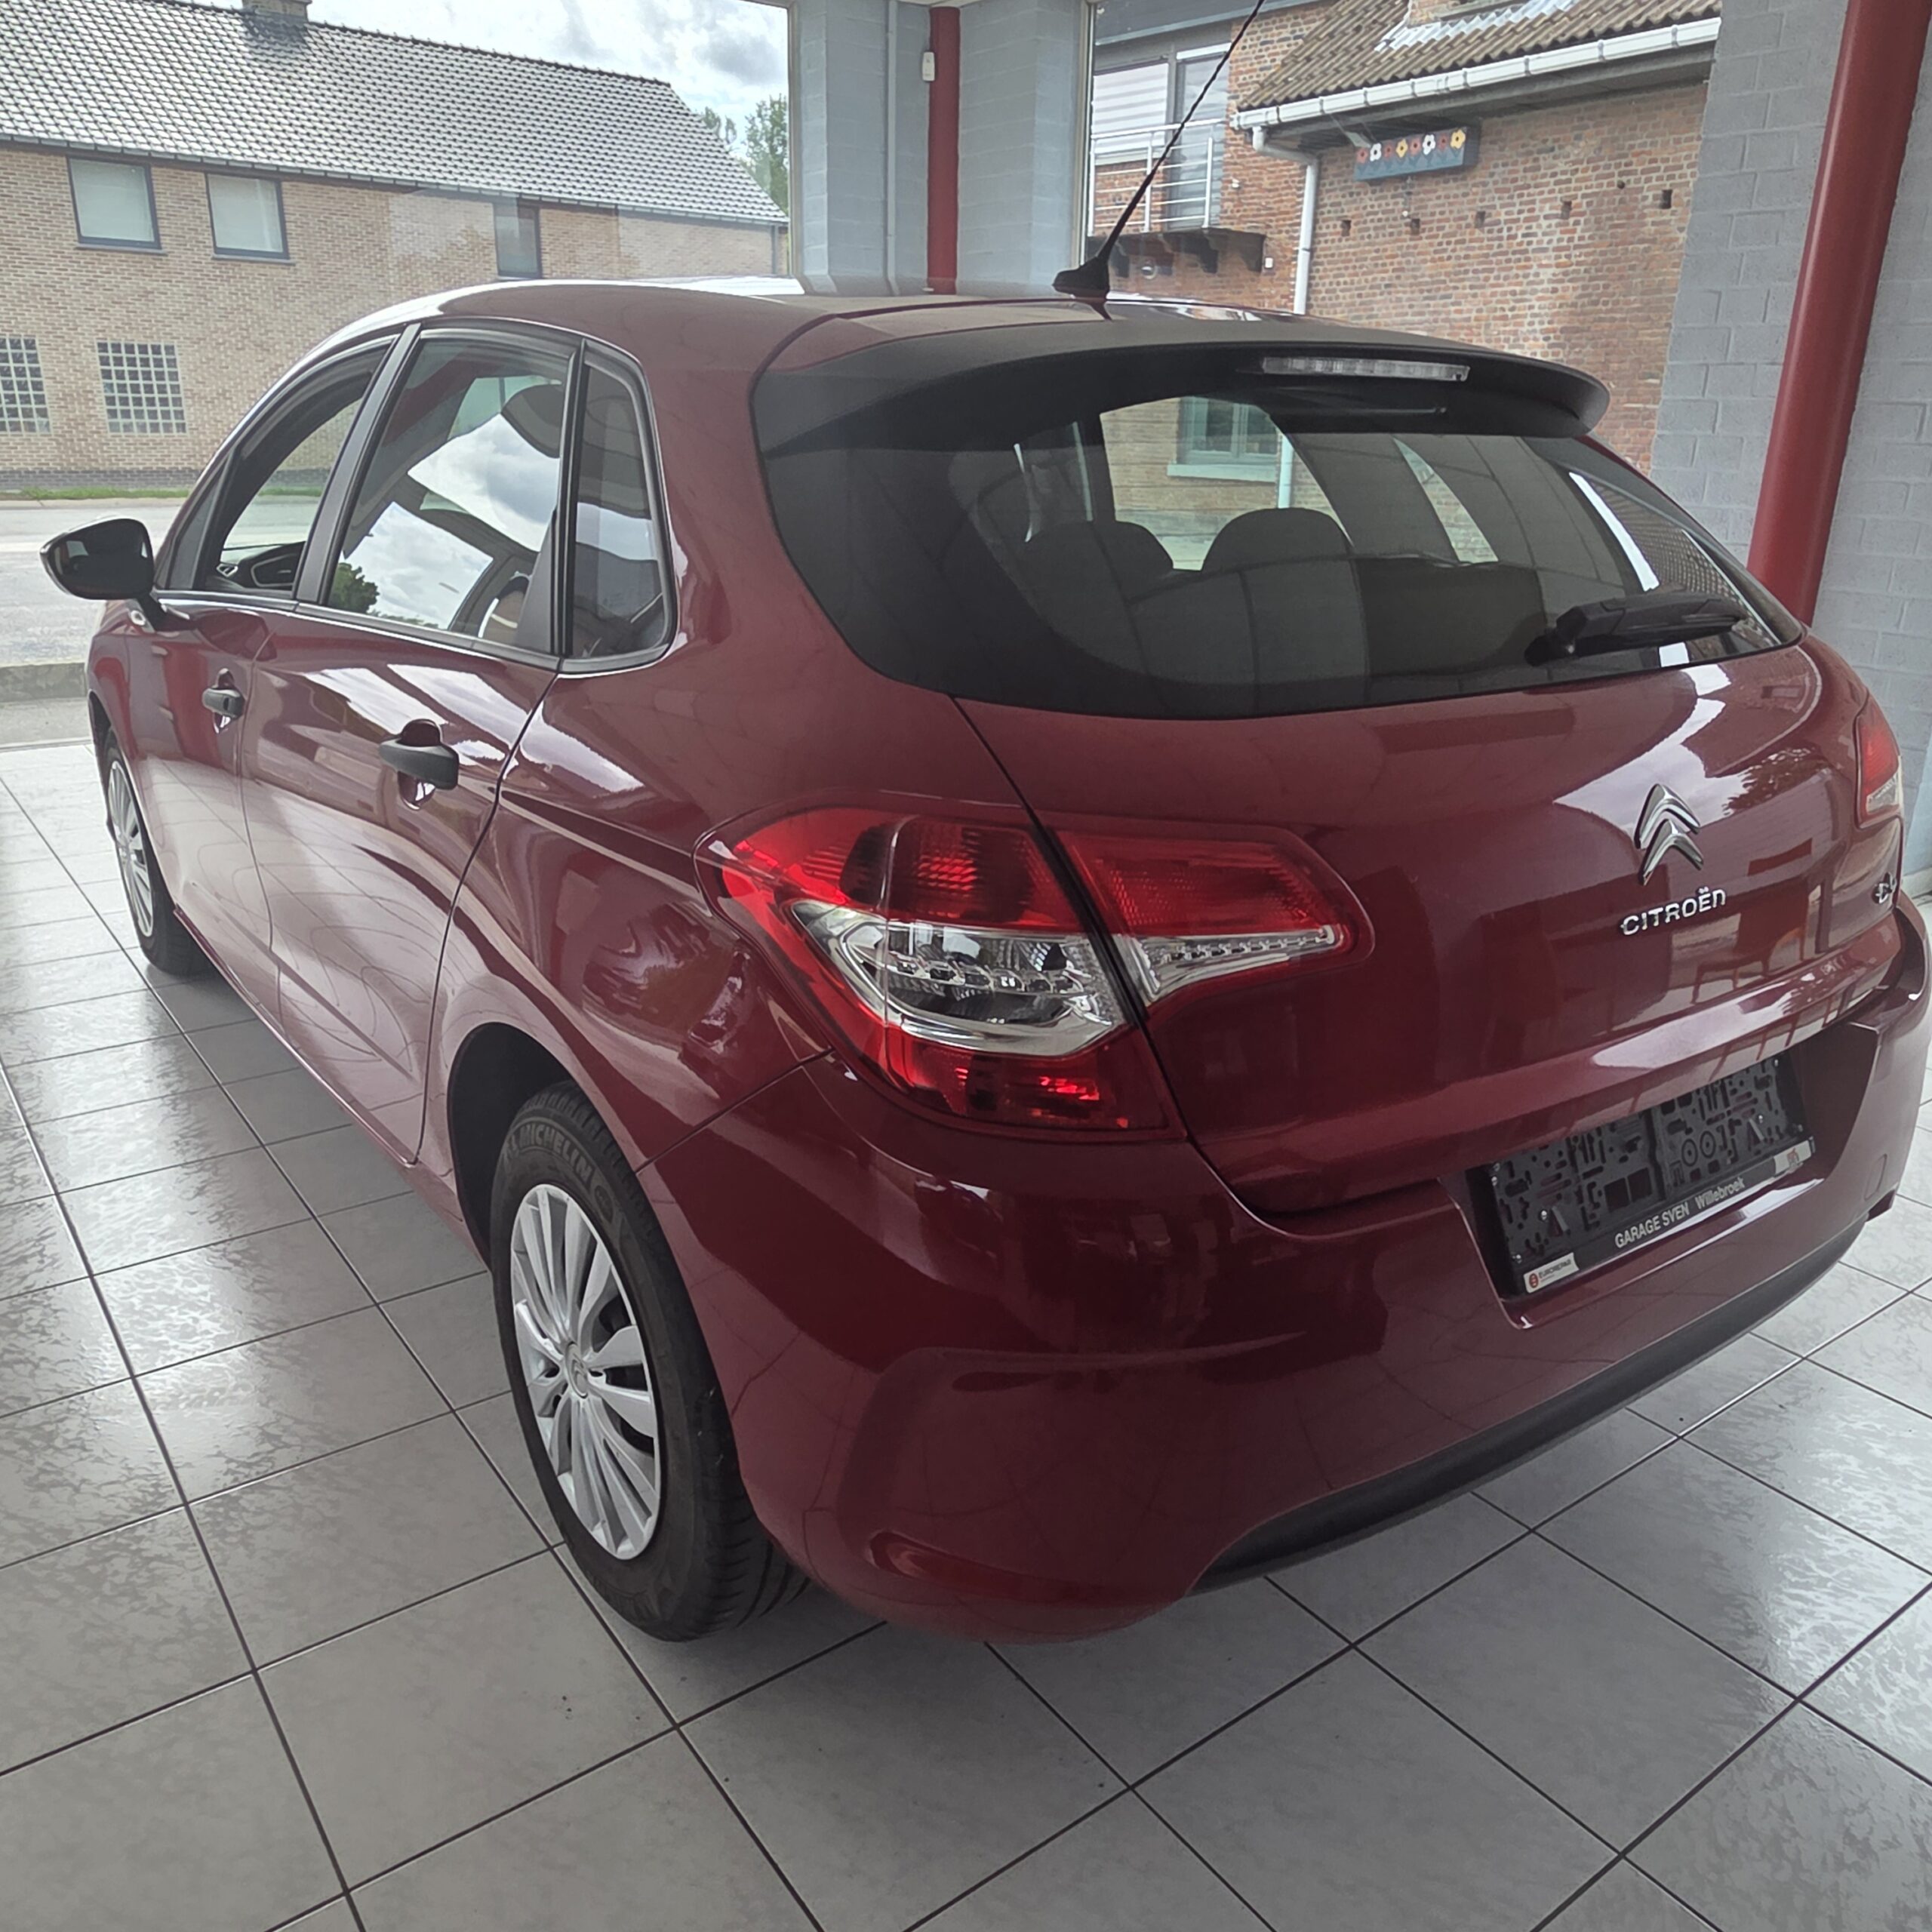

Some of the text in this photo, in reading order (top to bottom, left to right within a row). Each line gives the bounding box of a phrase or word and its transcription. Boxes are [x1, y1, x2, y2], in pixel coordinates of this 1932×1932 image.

[519, 1122, 592, 1184] MICHELIN
[1615, 1177, 1746, 1248] GARAGE SVEN Willebroek
